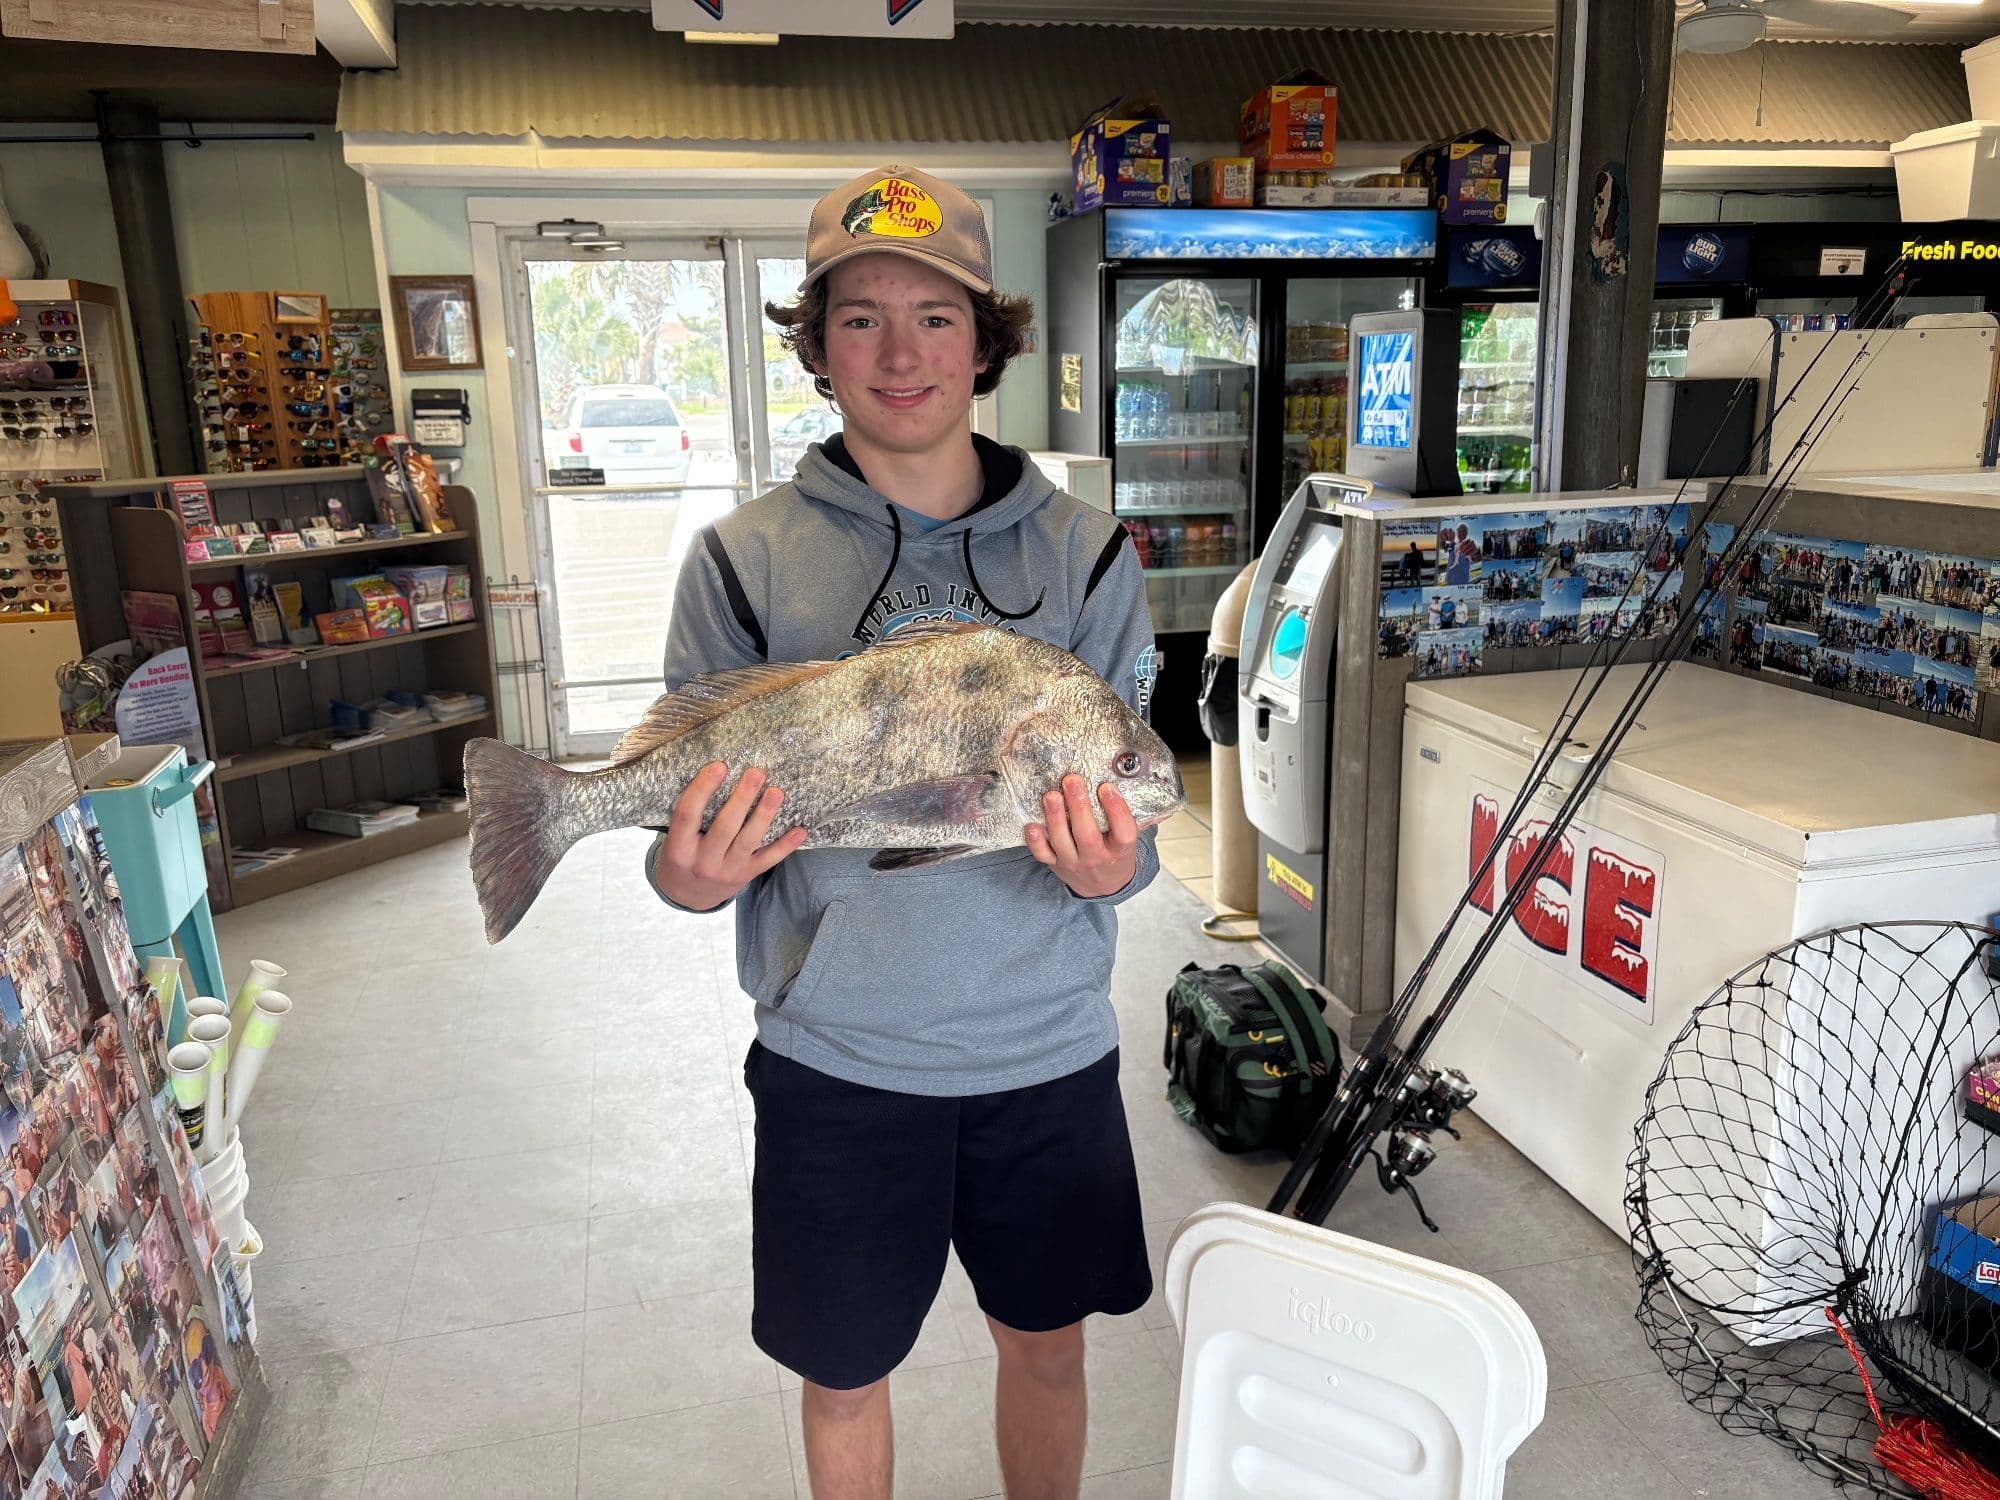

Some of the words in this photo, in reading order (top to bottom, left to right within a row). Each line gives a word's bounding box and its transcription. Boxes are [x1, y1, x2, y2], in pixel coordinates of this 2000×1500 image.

[885, 179, 926, 201] Bass
[886, 196, 917, 213] Pro
[1462, 207, 1494, 218] premiere
[889, 212, 936, 233] Shops
[1498, 242, 1519, 259] BUD
[1688, 243, 1718, 262] LIGHT
[1695, 238, 1717, 252] BUD
[1901, 241, 1956, 261] Fresh
[1960, 241, 2000, 260] Foo
[1489, 245, 1519, 267] LIGHT
[1361, 361, 1411, 397] ATM
[147, 666, 166, 675] Back
[167, 662, 187, 672] Saver
[128, 681, 139, 690] No
[139, 677, 159, 688] More
[159, 672, 190, 684] Bending
[1469, 793, 1656, 1004] ICE
[1287, 1287, 1376, 1344] igloo
